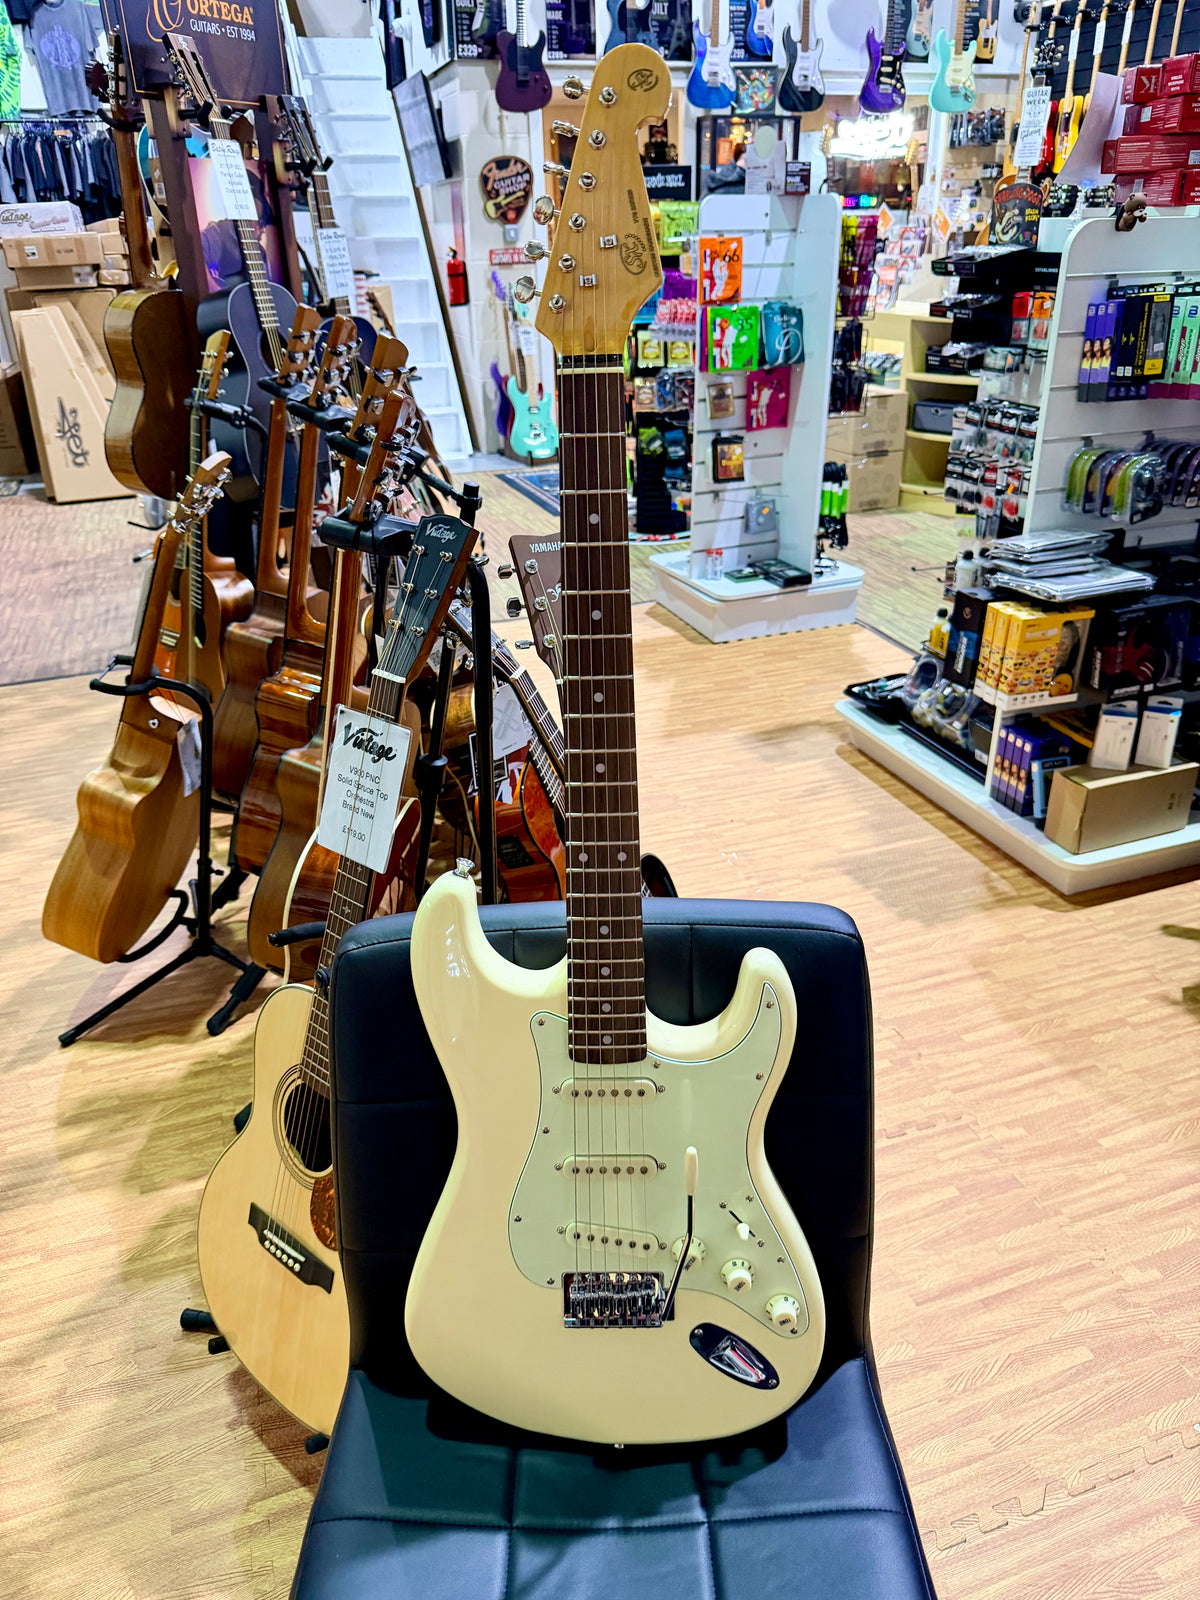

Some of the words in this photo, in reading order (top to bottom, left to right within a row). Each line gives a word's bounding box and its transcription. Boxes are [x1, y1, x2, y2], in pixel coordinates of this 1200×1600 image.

[186, 0, 254, 25] ORTEGA
[190, 18, 221, 36] GUITARS
[226, 25, 239, 39] EST
[239, 28, 256, 42] 1994
[1027, 89, 1049, 98] GUITAR
[493, 173, 531, 190] GUITAR
[722, 247, 740, 263] 66
[425, 522, 457, 543] Vintage
[343, 722, 397, 764] Vintage
[337, 773, 353, 786] Solid
[376, 788, 389, 801] Top
[365, 772, 380, 784] PNC
[360, 808, 375, 821] New
